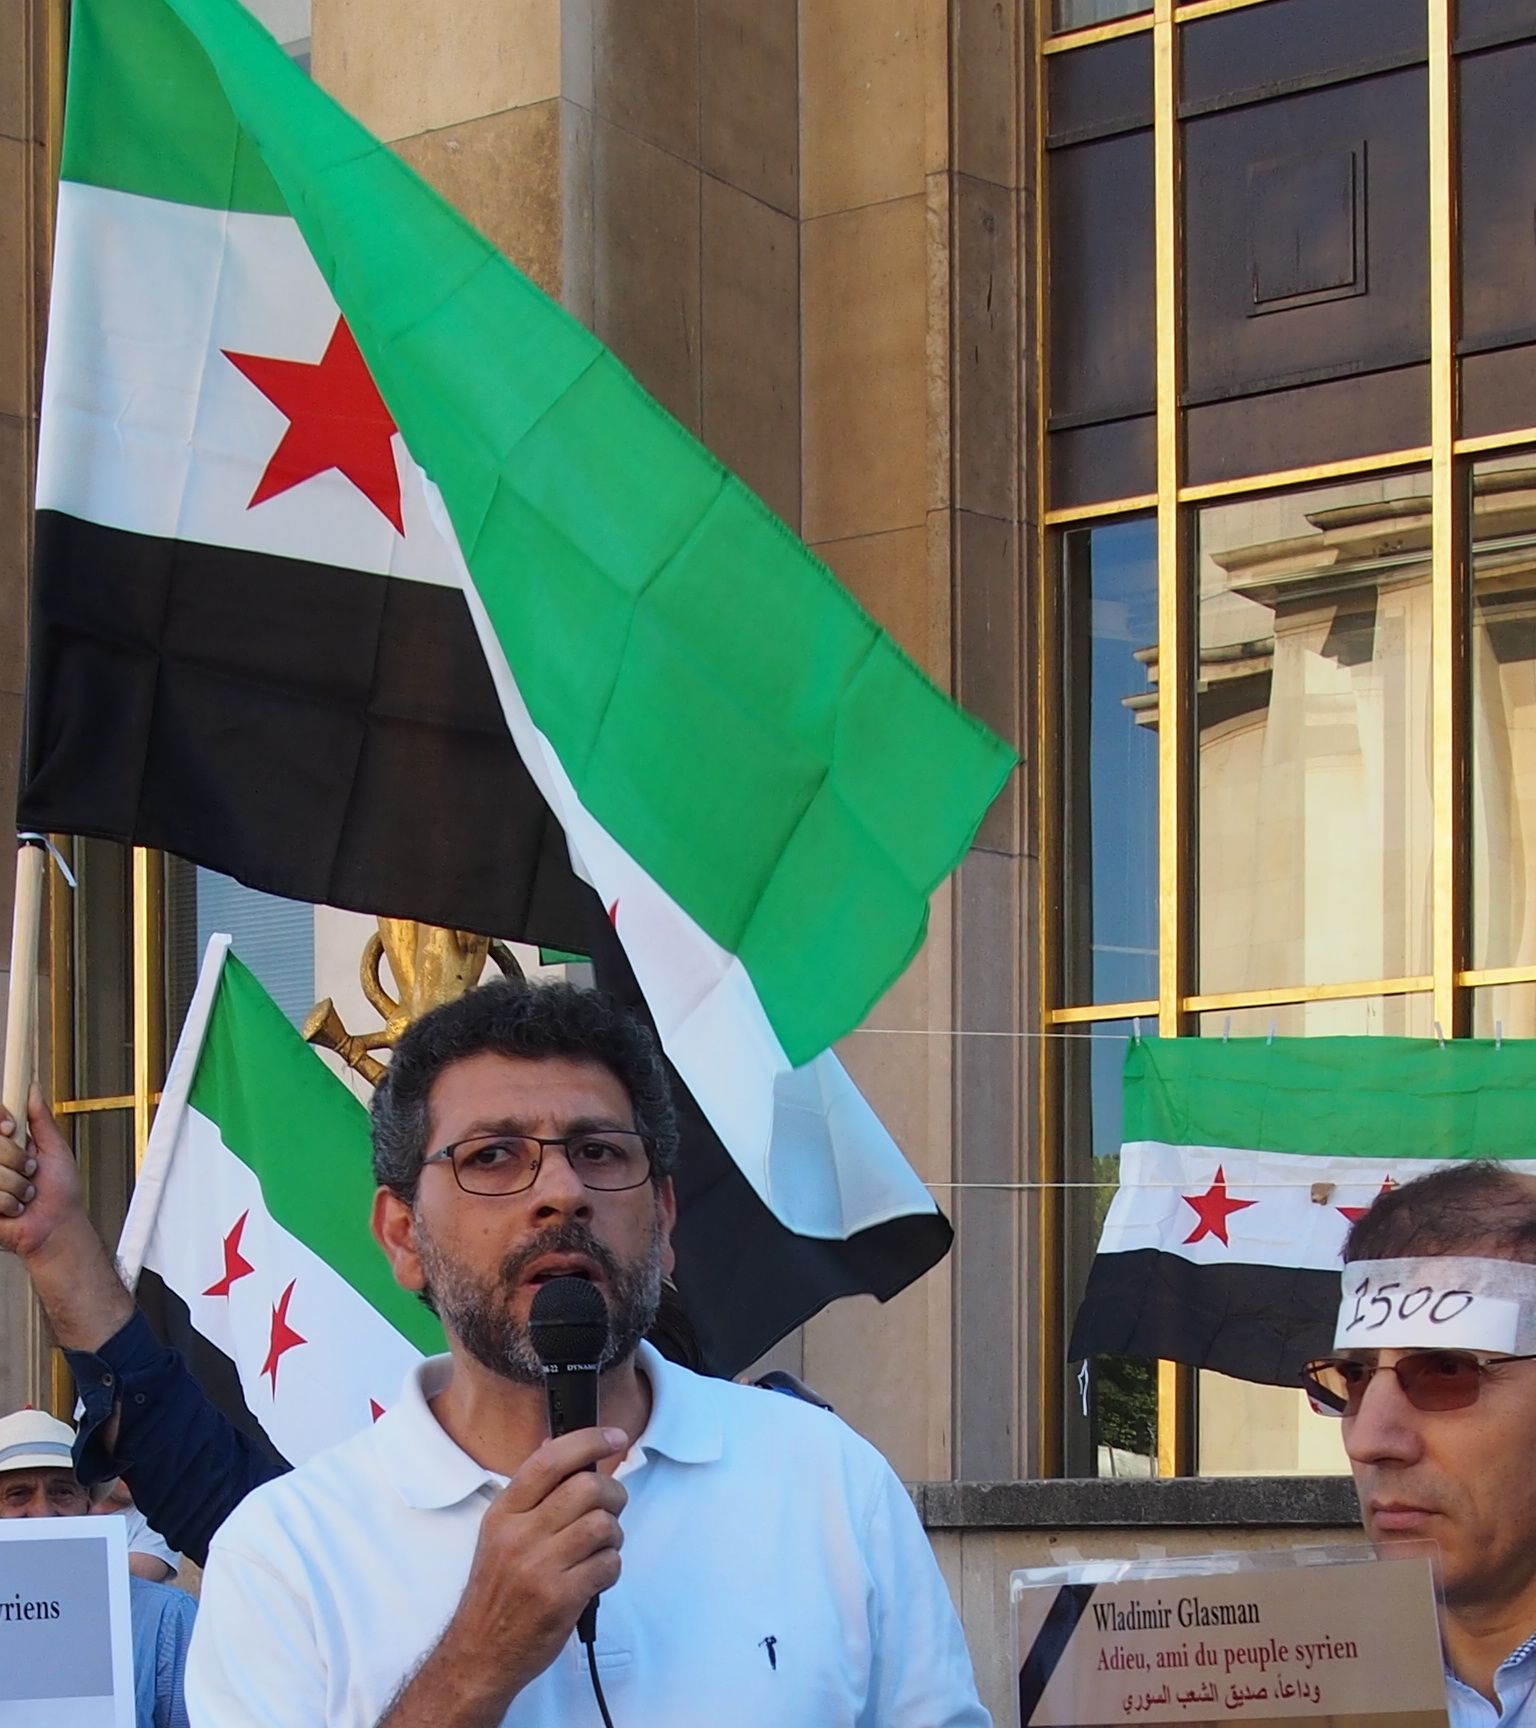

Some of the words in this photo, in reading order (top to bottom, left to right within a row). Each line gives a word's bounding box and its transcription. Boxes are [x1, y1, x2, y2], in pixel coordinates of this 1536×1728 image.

[1346, 1277, 1474, 1331] 1500
[1093, 1599, 1172, 1632] Wladimir
[1178, 1597, 1260, 1629] Glasman
[1097, 1646, 1151, 1673] Adieu,
[1156, 1645, 1189, 1668] ami
[1195, 1643, 1218, 1667] du
[1224, 1639, 1288, 1674] peuple
[1295, 1637, 1358, 1672] syrien
[1122, 1685, 1170, 1714] السوري
[1177, 1682, 1219, 1709] الشعب
[1224, 1683, 1267, 1711] صديق
